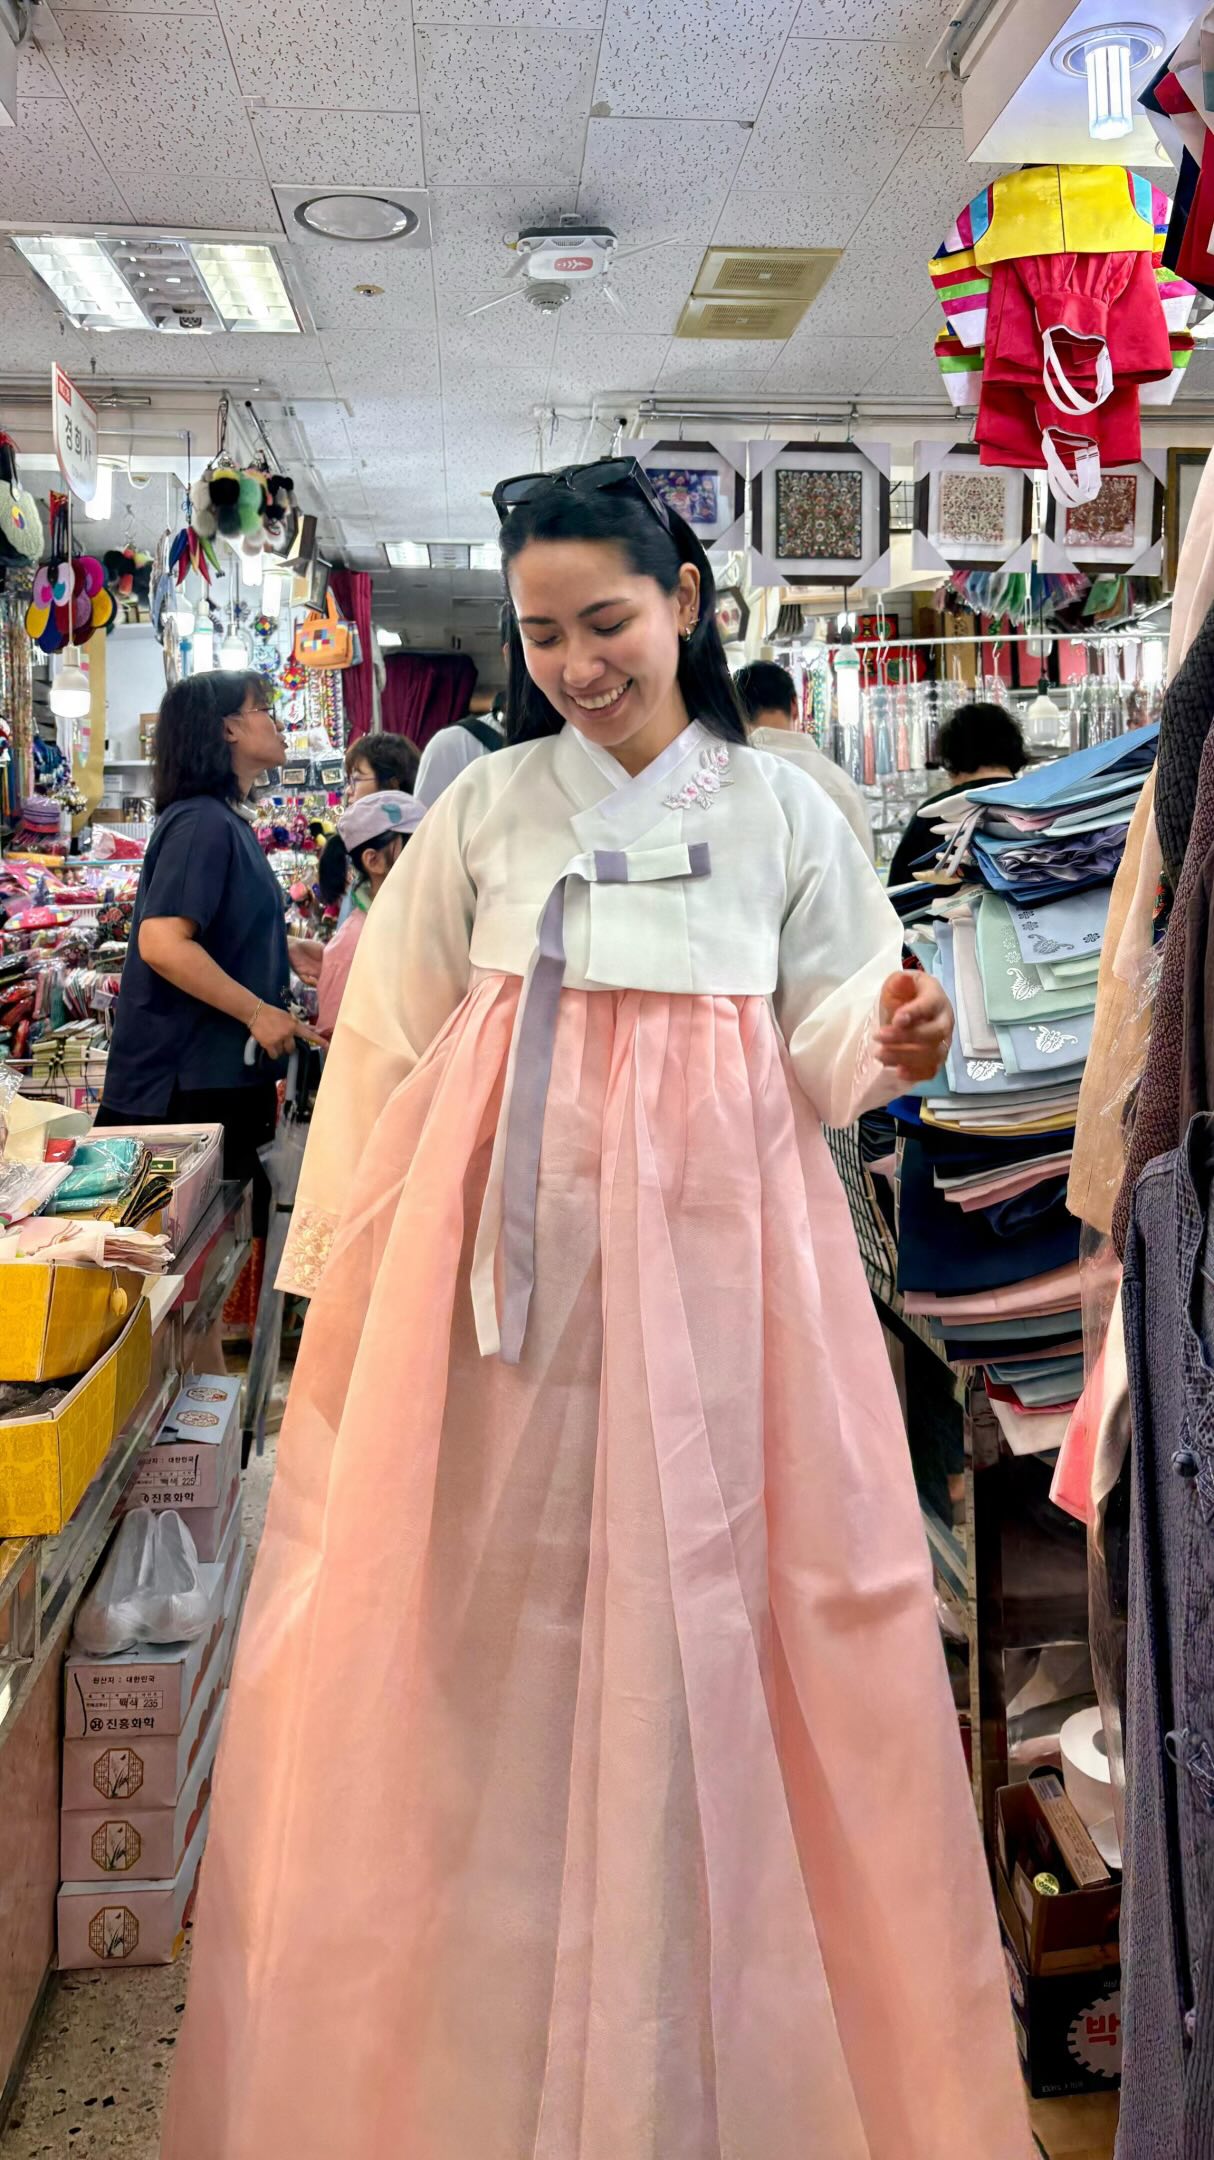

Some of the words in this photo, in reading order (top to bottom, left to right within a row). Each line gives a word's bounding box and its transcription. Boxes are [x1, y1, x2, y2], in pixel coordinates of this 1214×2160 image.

[182, 1477, 195, 1486] 225
[151, 1492, 194, 1503] 진흥화학
[93, 1676, 115, 1685] 원산지
[126, 1675, 155, 1684] 대한민국
[143, 1699, 158, 1708] 235
[106, 1716, 154, 1730] 진흥화학
